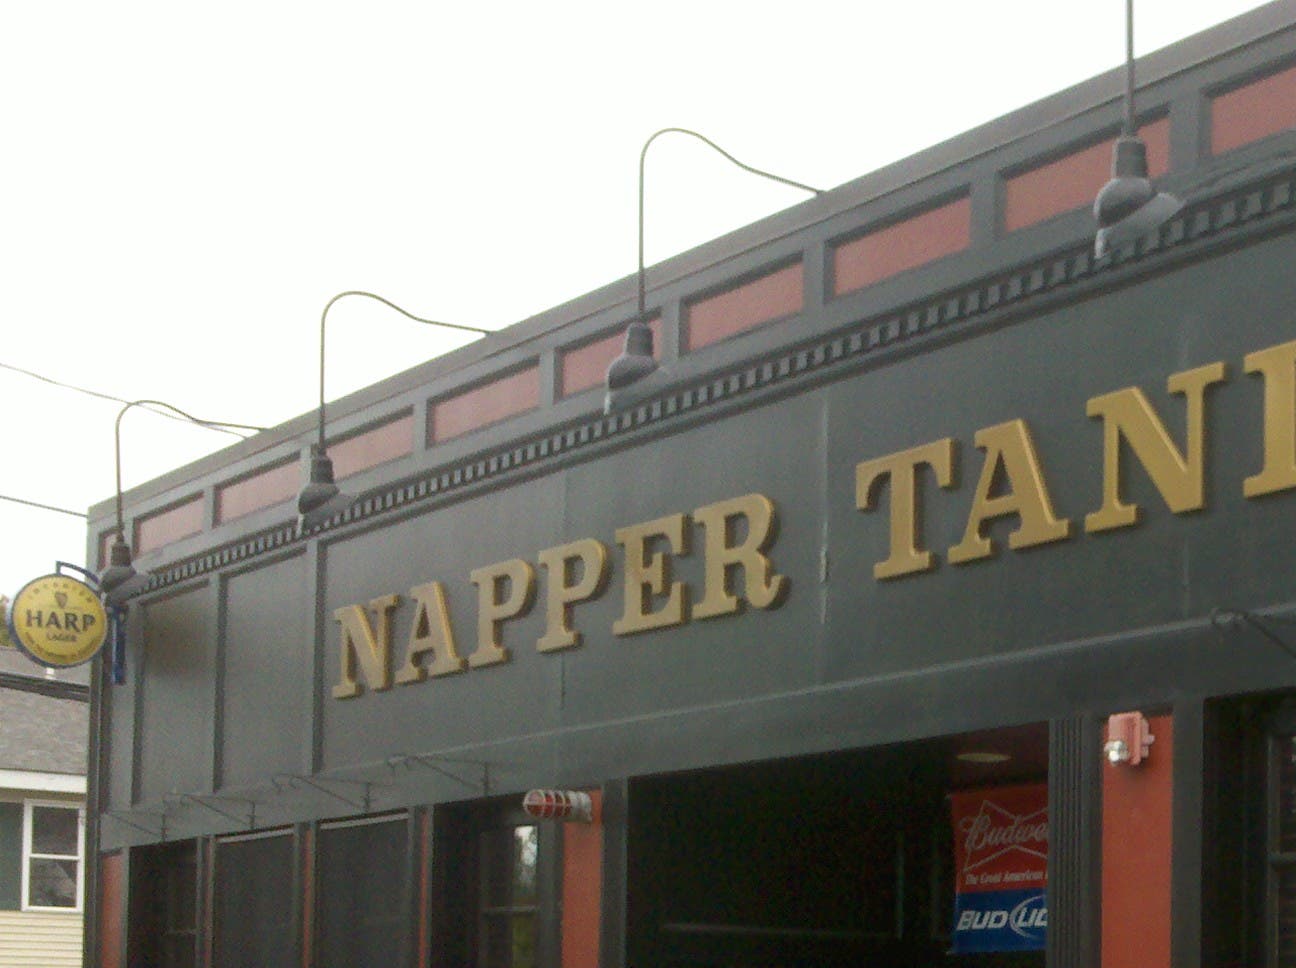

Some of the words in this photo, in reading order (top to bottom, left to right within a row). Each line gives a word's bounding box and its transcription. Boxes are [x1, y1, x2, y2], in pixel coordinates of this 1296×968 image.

[332, 493, 786, 699] NAPPER
[26, 608, 97, 632] HARP
[959, 813, 1048, 850] Budwe
[1003, 869, 1044, 883] American
[956, 910, 1009, 931] BUD
